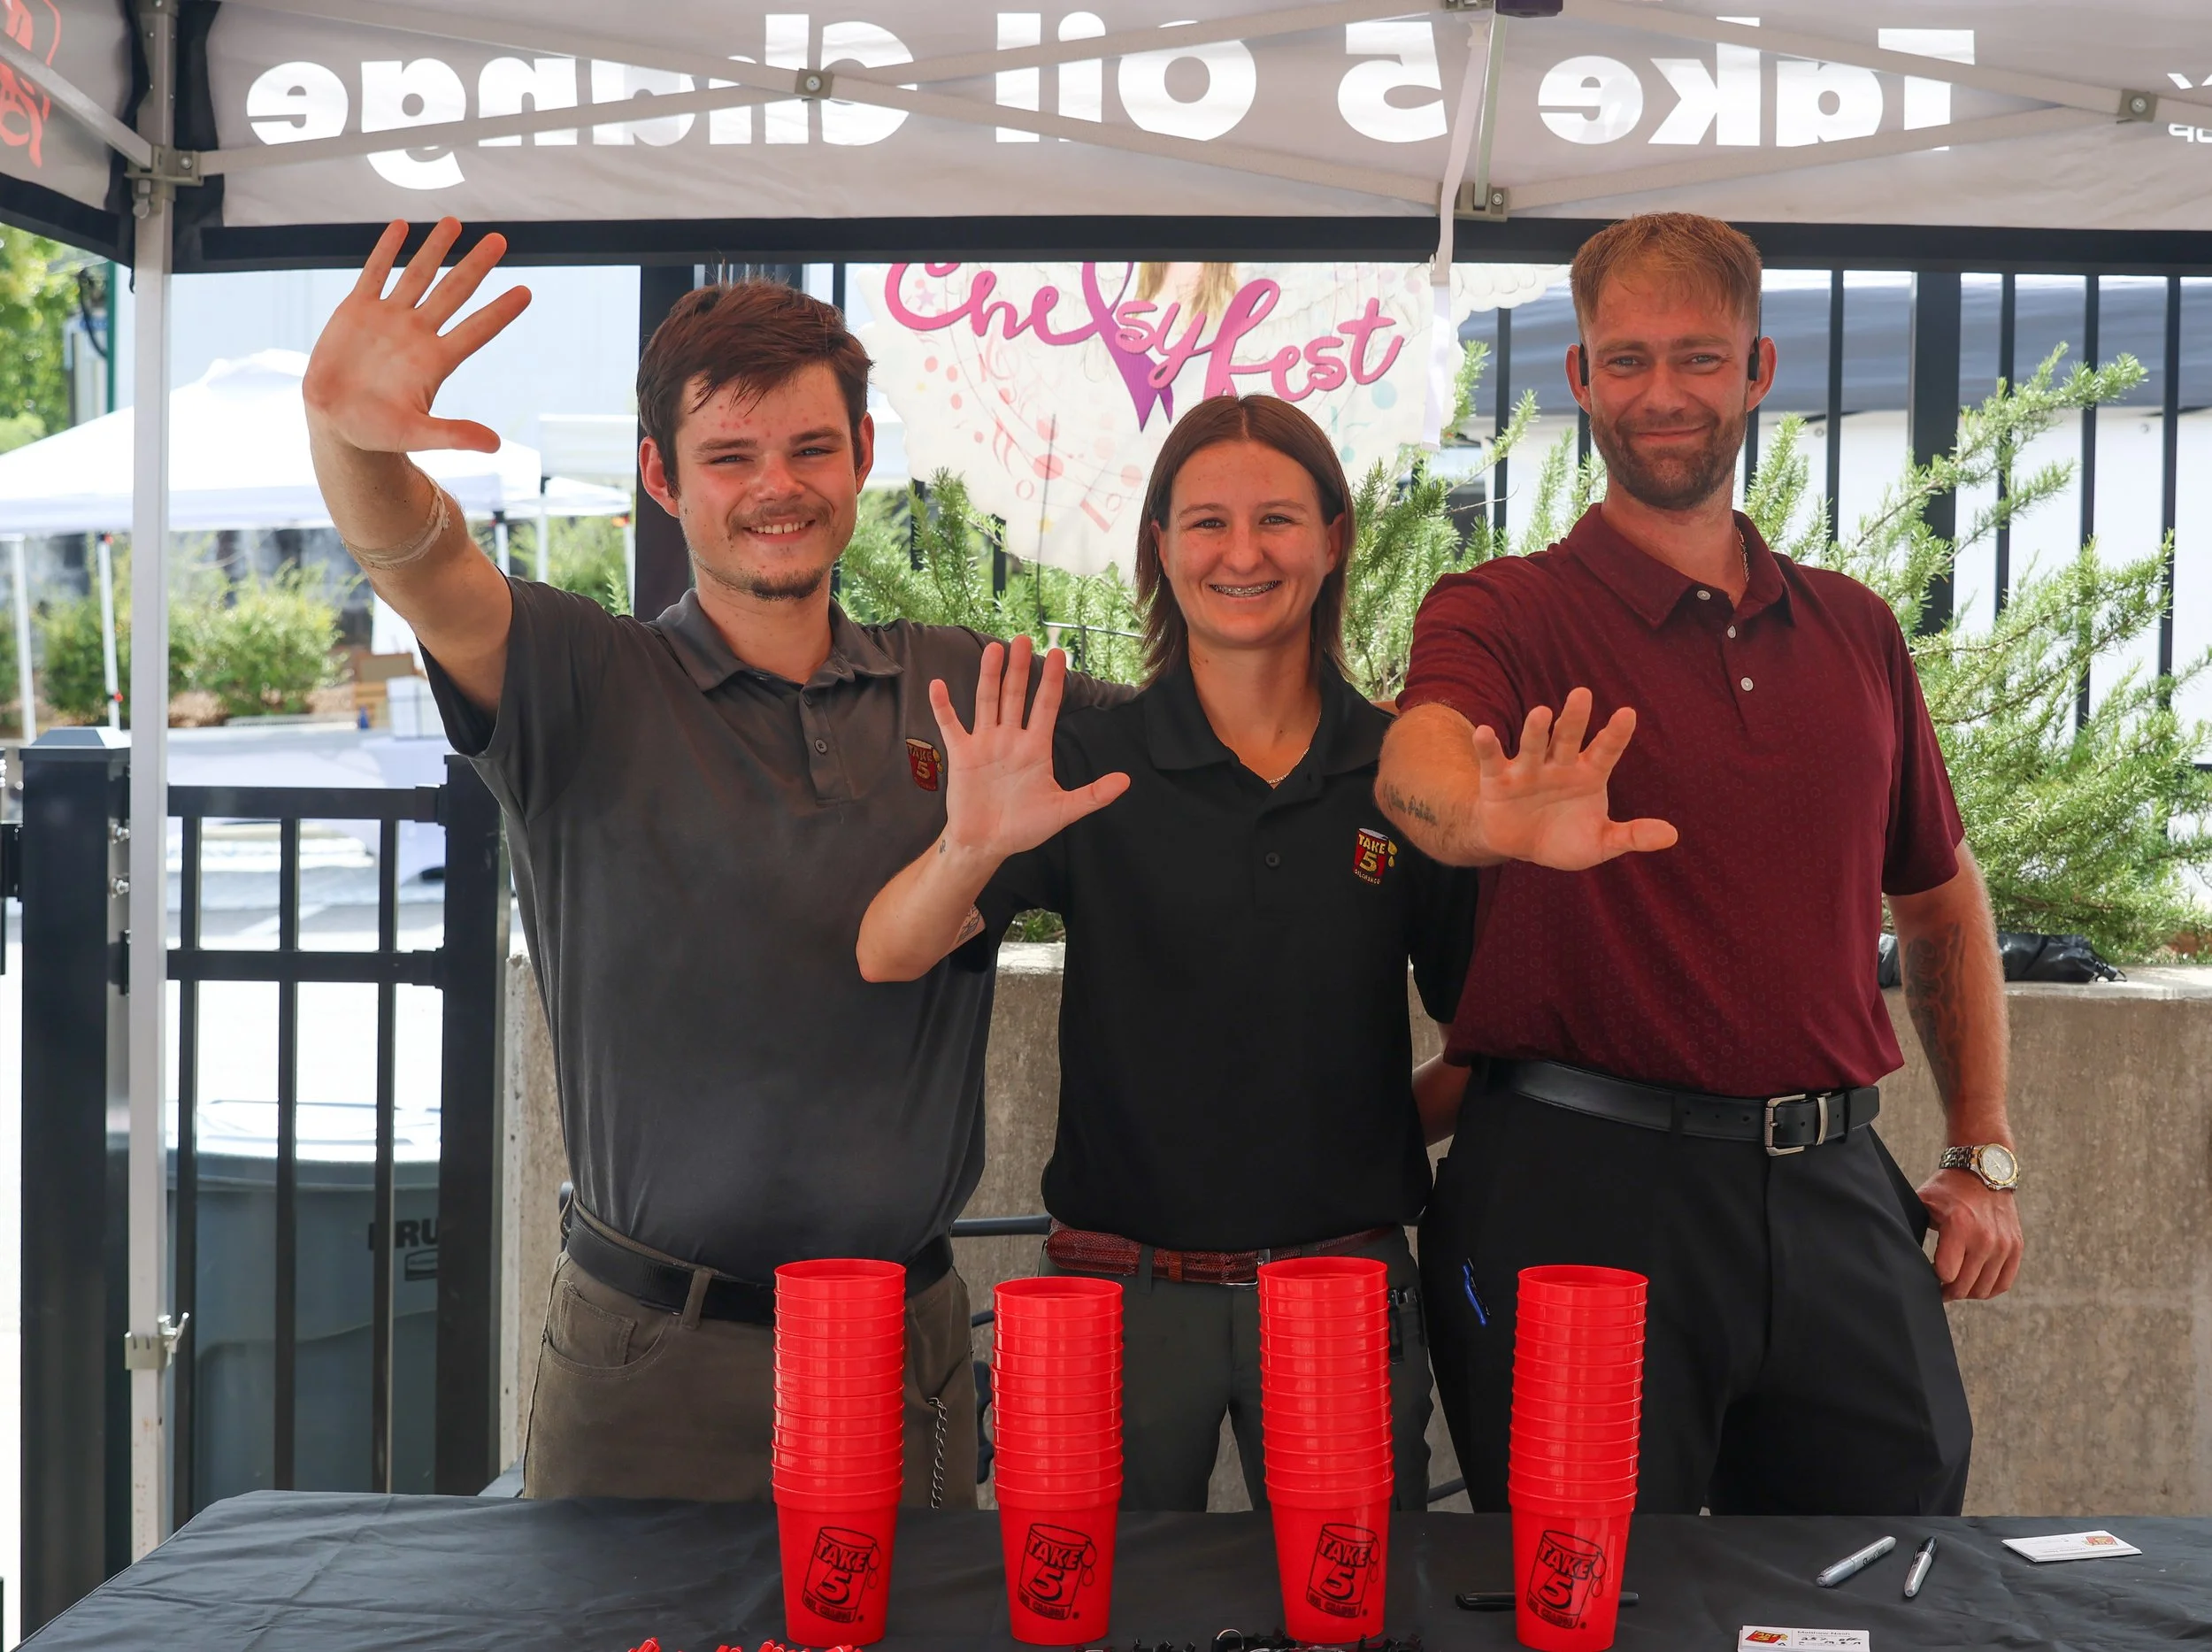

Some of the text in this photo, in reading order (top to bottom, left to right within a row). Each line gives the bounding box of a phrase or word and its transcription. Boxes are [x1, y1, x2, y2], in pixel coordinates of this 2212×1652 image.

[917, 760, 931, 779] 5
[1358, 834, 1386, 855] TAKE
[1359, 850, 1378, 872] 5
[817, 1538, 868, 1572] TAKE
[1028, 1535, 1083, 1570] TAKE
[1319, 1536, 1371, 1568] TAKE
[1540, 1543, 1593, 1579] TAKE
[815, 1568, 852, 1604] 5
[1028, 1564, 1064, 1602] 5
[1320, 1564, 1356, 1601] 5
[1539, 1571, 1574, 1610] 5
